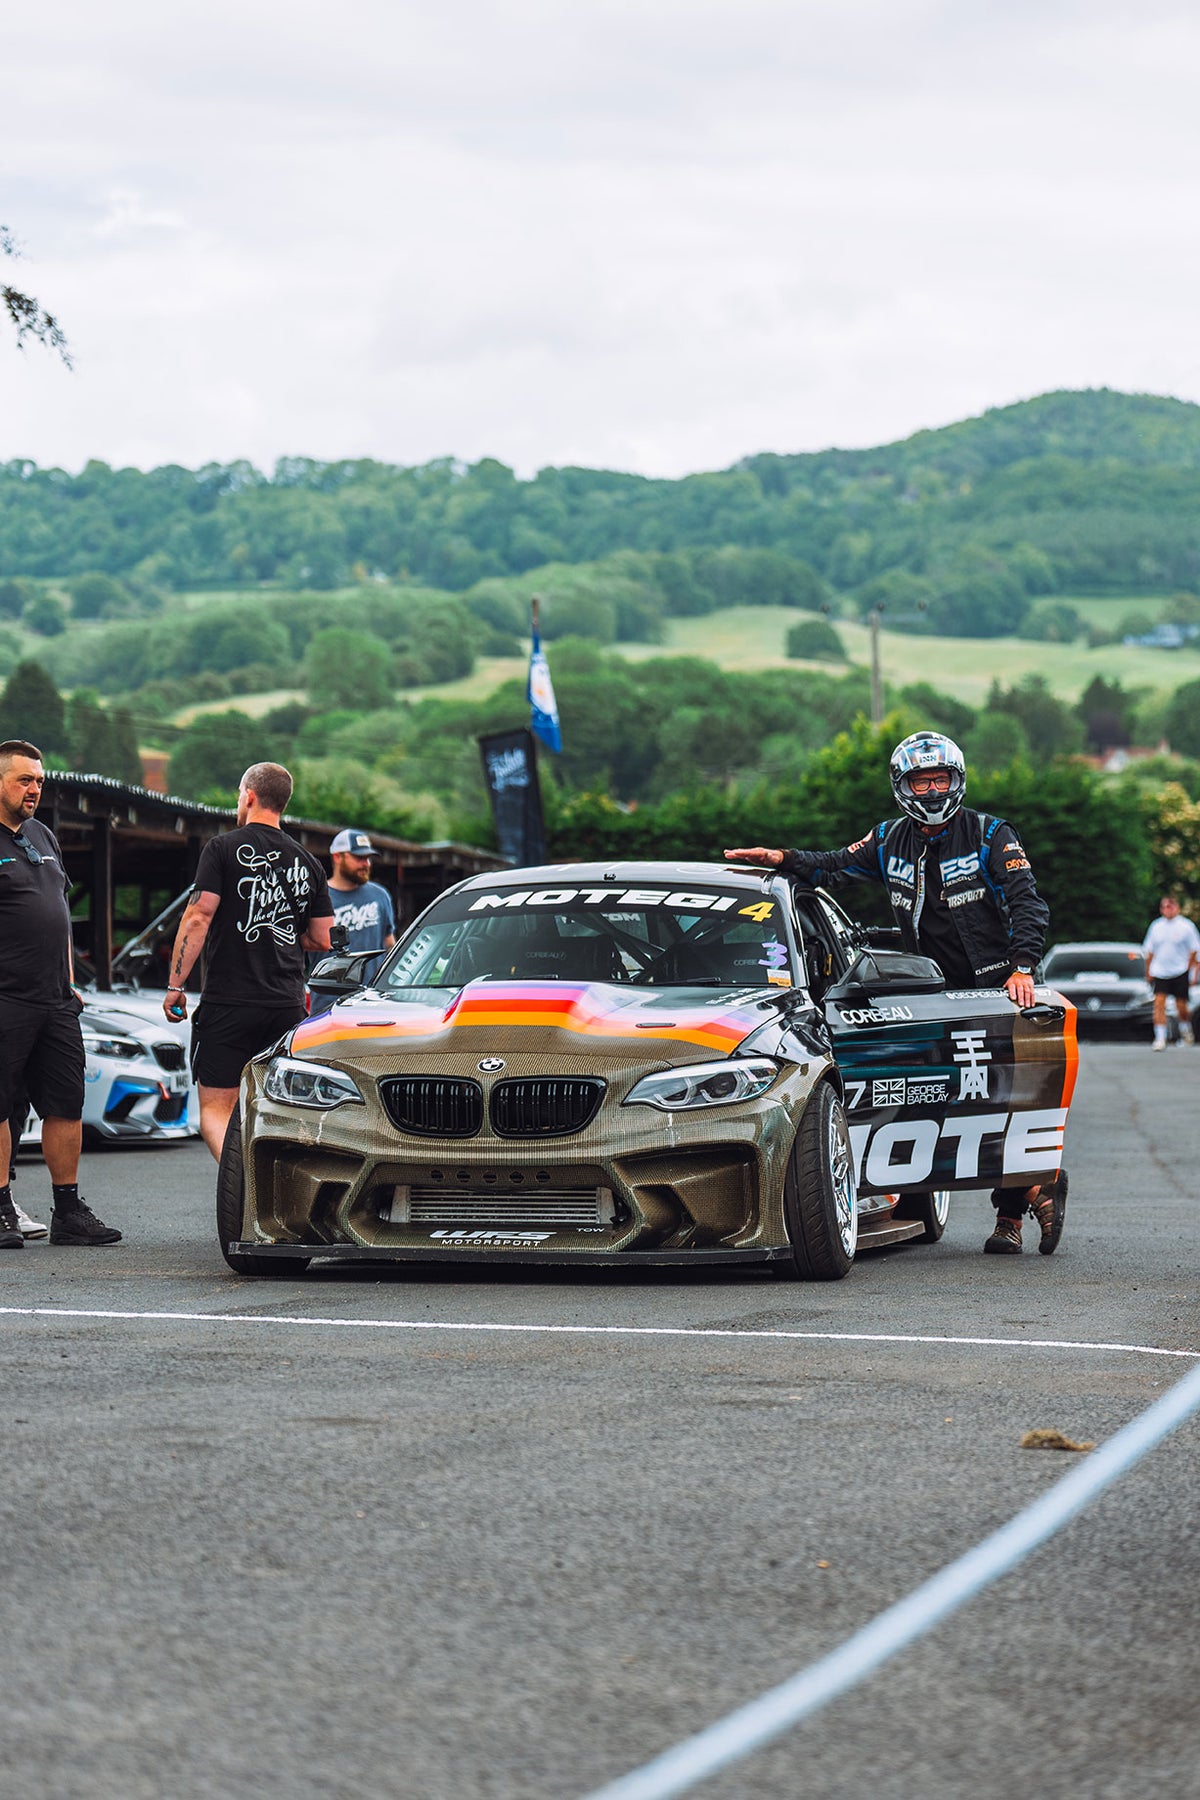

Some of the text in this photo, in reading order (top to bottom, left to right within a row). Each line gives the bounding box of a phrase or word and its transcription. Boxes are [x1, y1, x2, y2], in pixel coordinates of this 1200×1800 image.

[468, 888, 776, 922] MOTEGI 4
[758, 942, 788, 967] 3
[840, 1005, 913, 1025] CORBEAU
[907, 1083, 946, 1096] GEORGE
[907, 1093, 949, 1105] BARCLAY
[441, 1239, 541, 1248] MOTORSPORT
